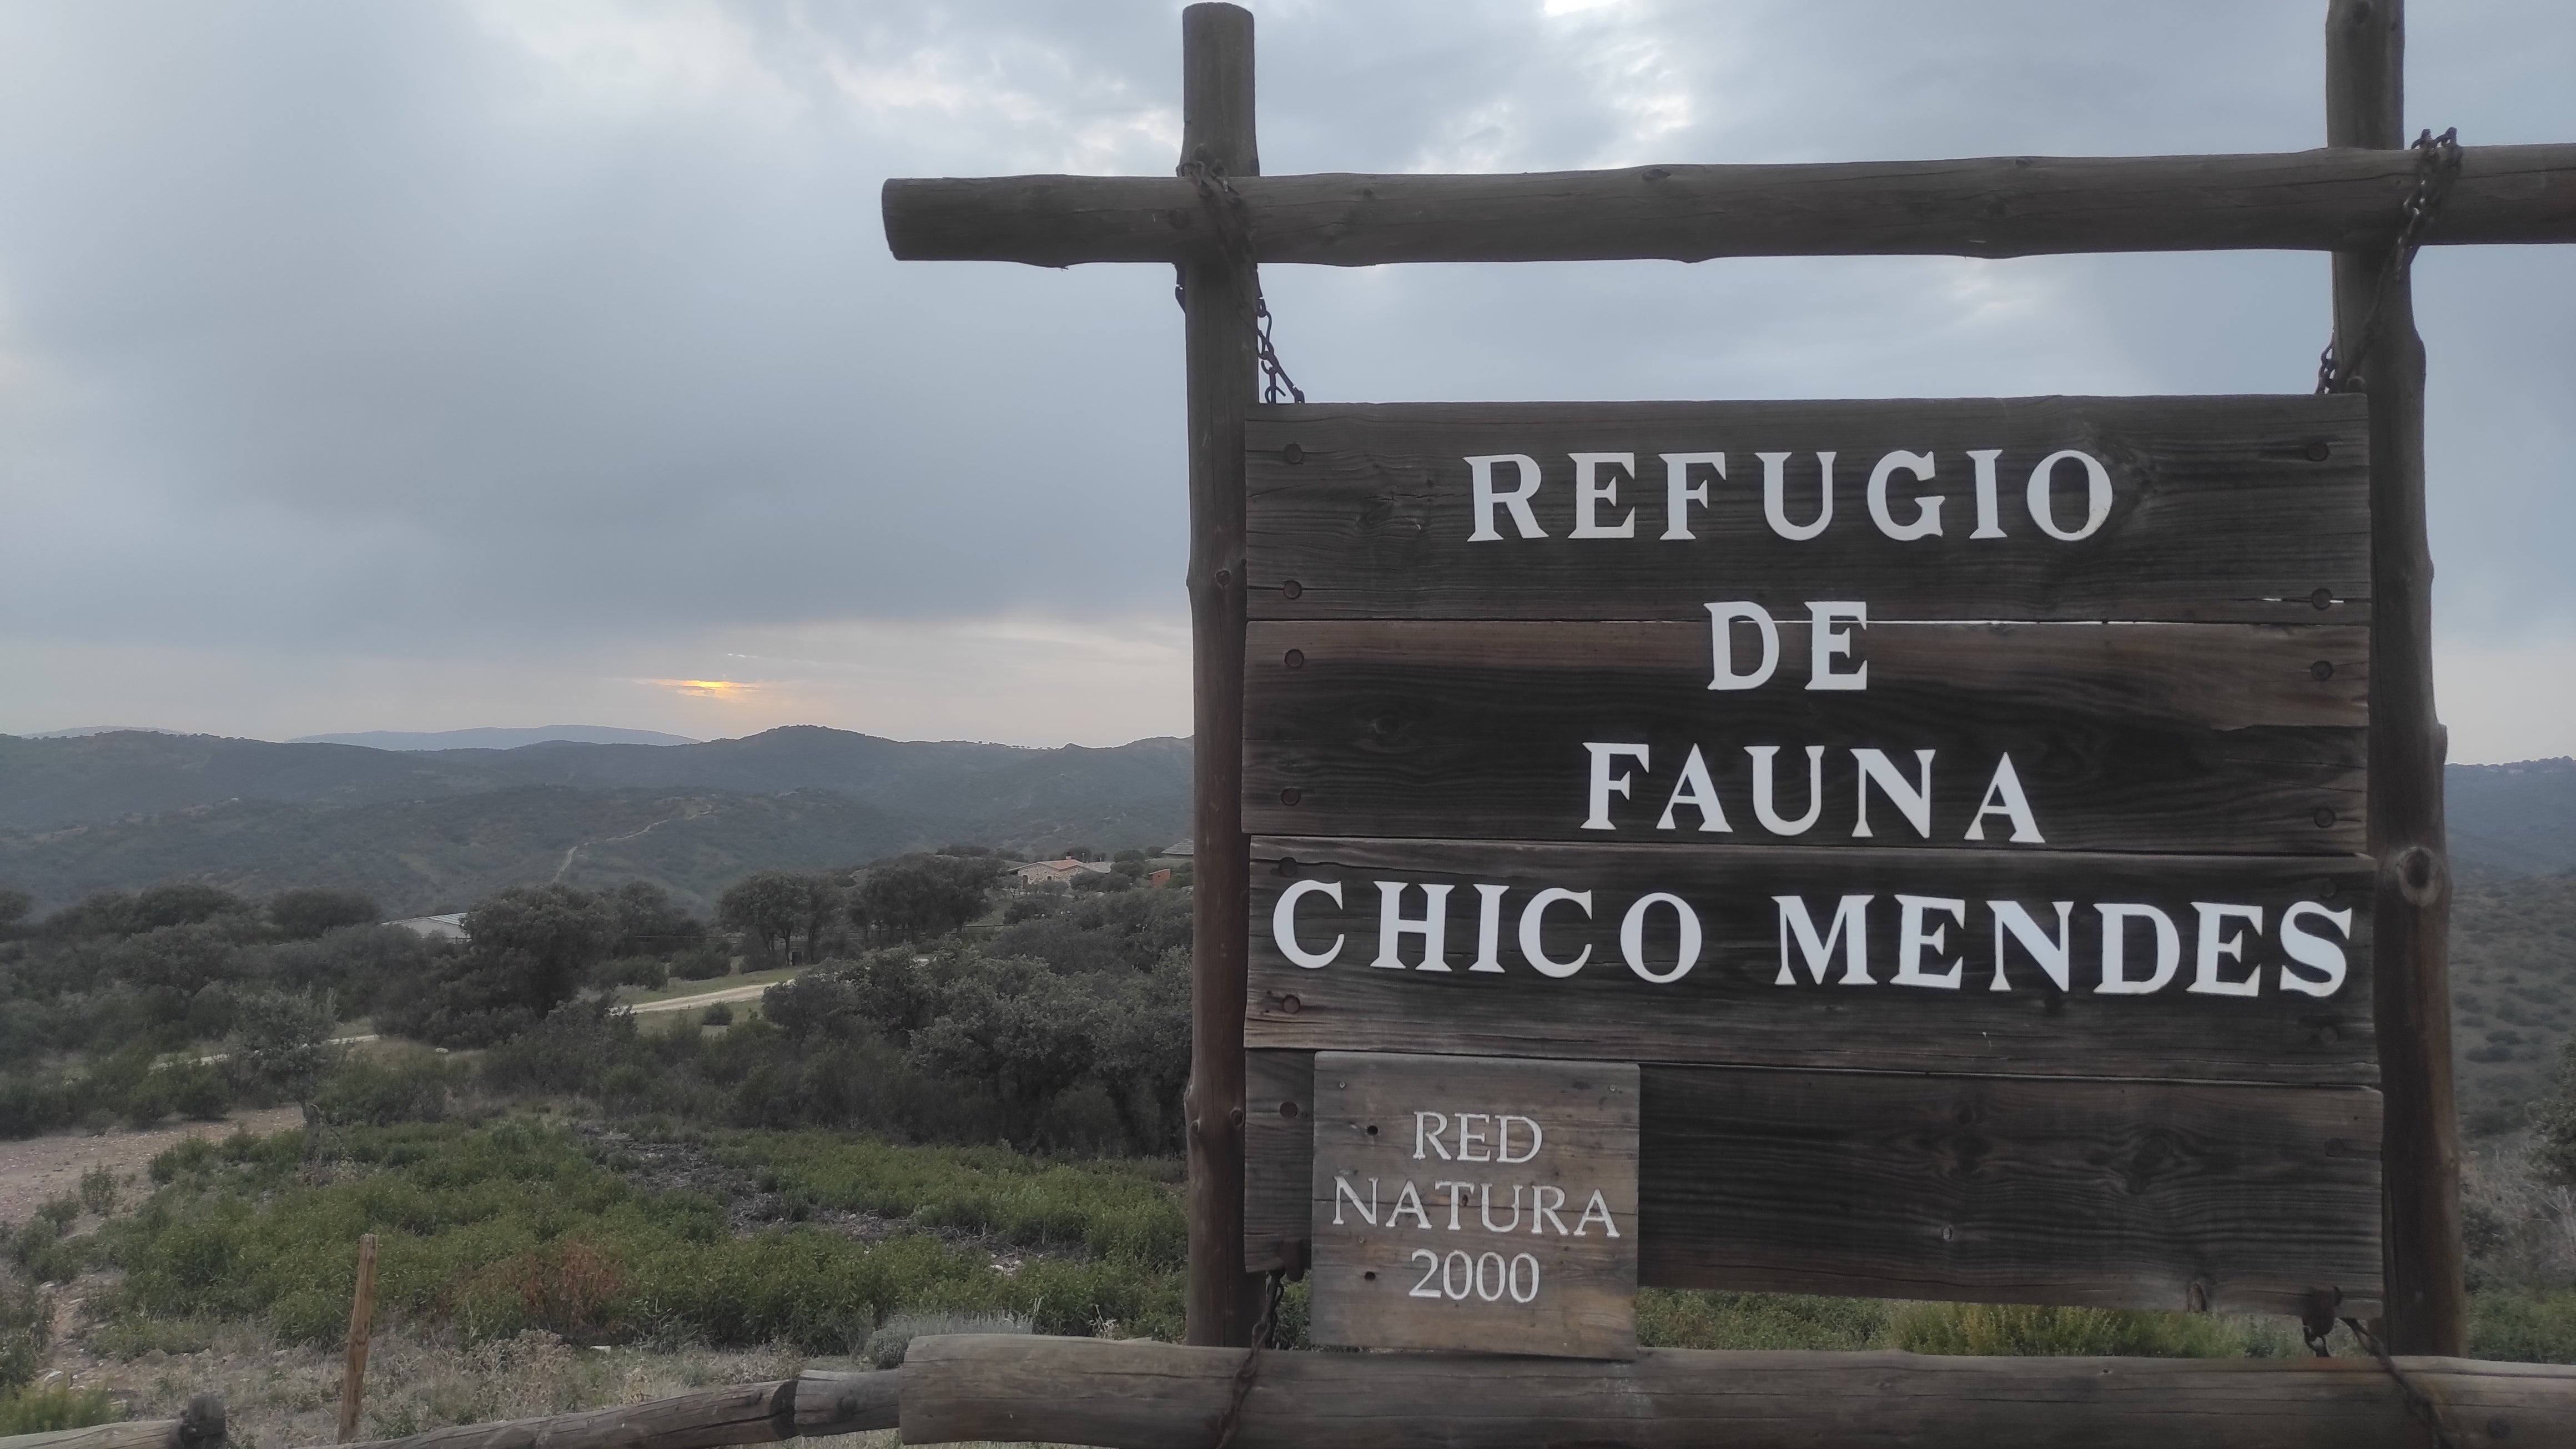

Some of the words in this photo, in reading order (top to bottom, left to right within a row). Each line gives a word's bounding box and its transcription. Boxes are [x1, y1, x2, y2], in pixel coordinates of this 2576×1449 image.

[1463, 449, 2113, 542] REFUGIO
[1705, 600, 1869, 691] DE
[1581, 742, 2046, 844] FAUNA
[1272, 879, 1702, 983] CHICO
[1772, 894, 2353, 998] MENDES
[1412, 1110, 1543, 1164] RED
[1331, 1176, 1621, 1239] NATURA
[1407, 1248, 1540, 1304] 2000
